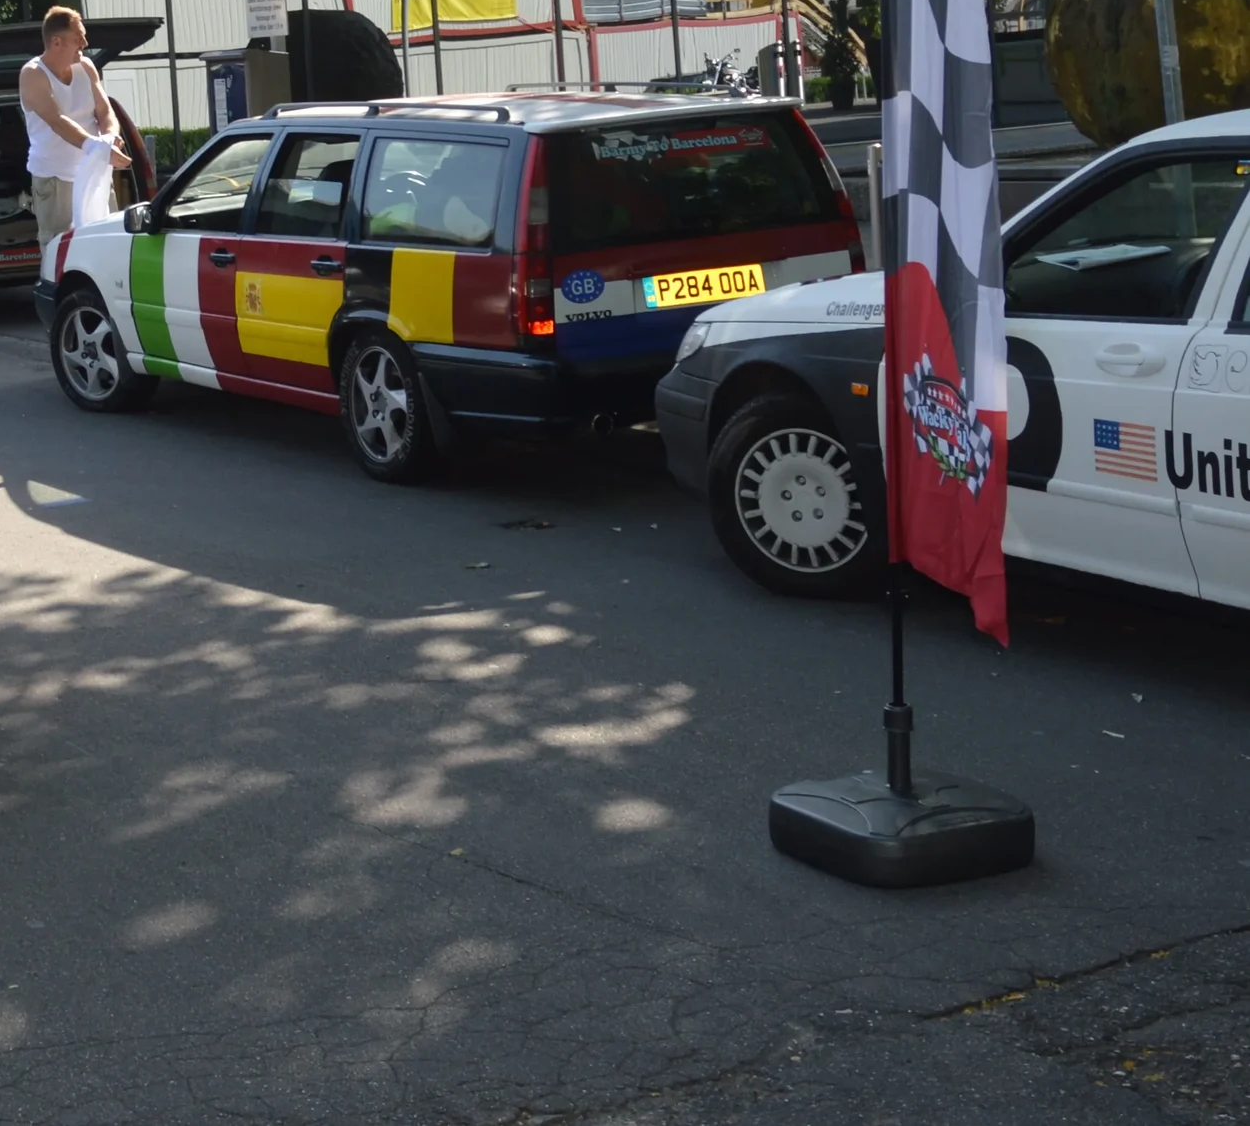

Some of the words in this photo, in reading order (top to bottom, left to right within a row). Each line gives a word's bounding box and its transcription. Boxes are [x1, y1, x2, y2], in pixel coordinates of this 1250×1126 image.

[601, 144, 648, 159] Barmy
[670, 134, 737, 150] Barcelona
[571, 278, 595, 296] GB
[658, 274, 713, 301] P284
[565, 309, 613, 323] VOLVO
